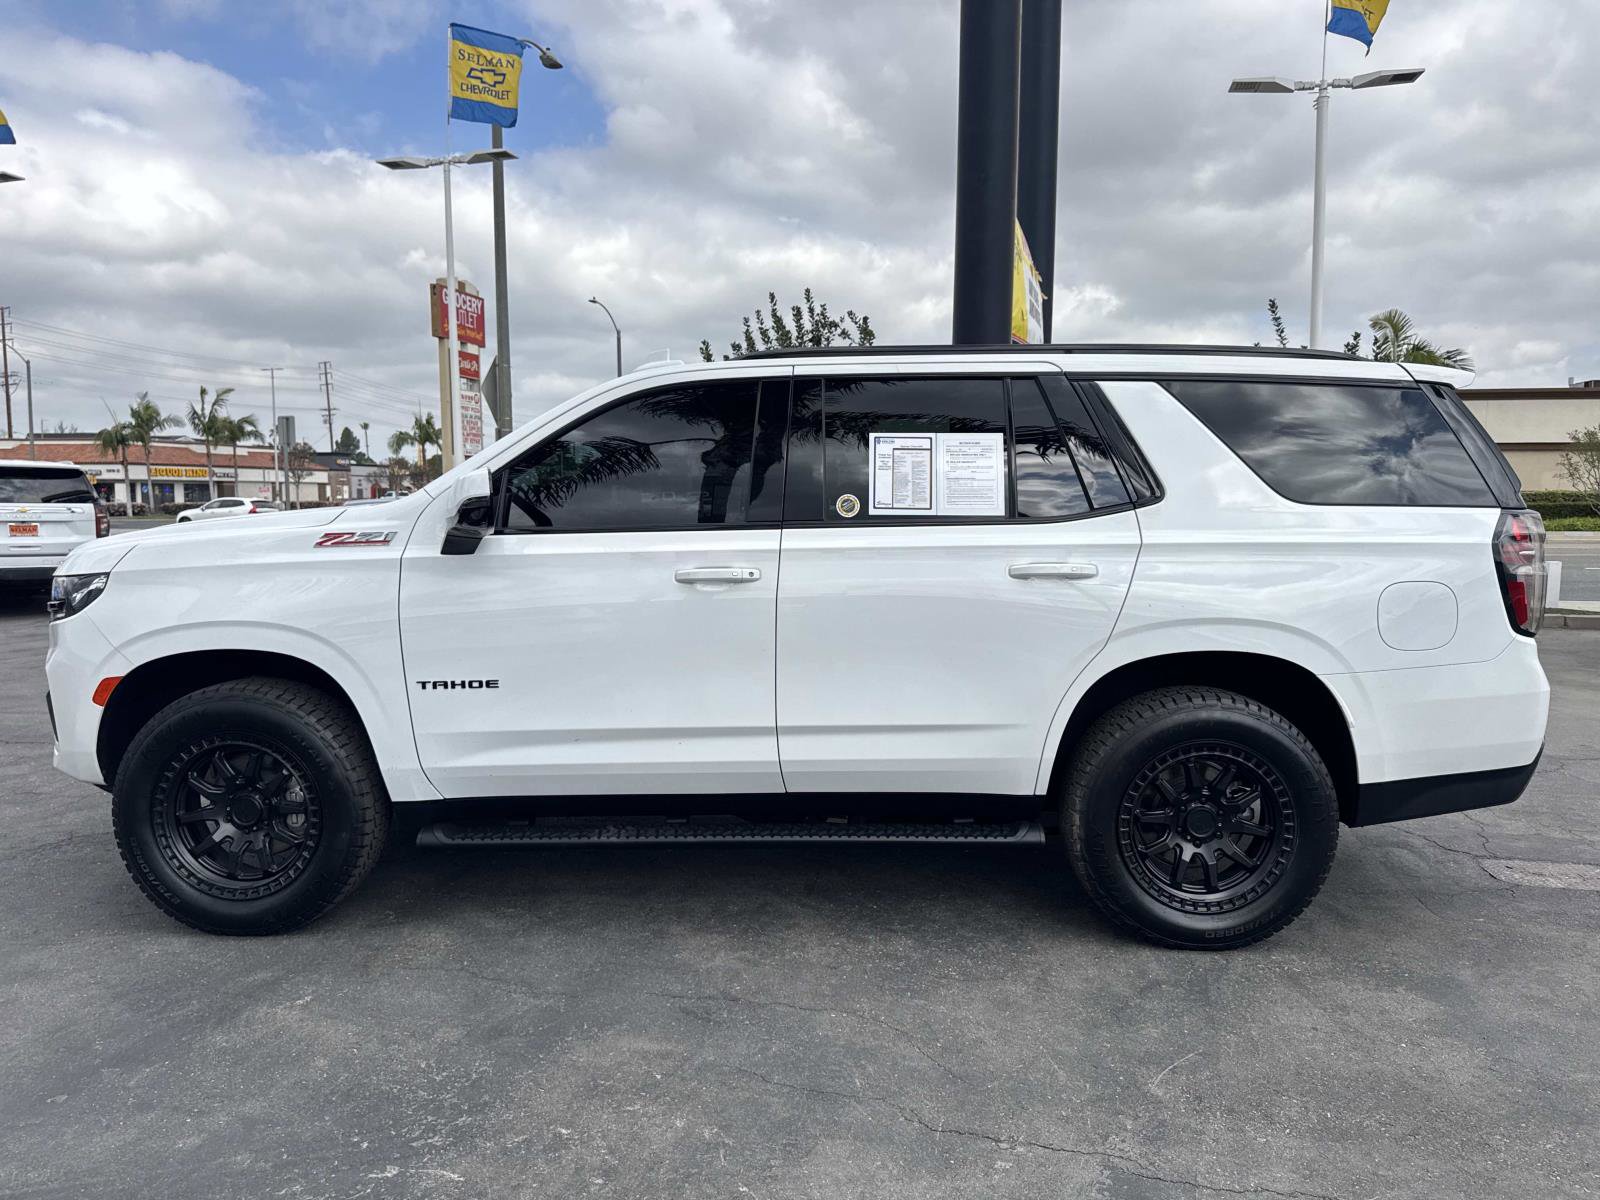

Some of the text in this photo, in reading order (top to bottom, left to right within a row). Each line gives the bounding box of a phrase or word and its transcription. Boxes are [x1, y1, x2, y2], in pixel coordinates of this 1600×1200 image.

[458, 48, 516, 69] SELMAN
[460, 82, 512, 100] CHEVROLET
[442, 288, 482, 314] GOCERY
[457, 309, 478, 329] UTLET
[313, 531, 398, 548] Z71
[416, 679, 500, 690] TAHOE
